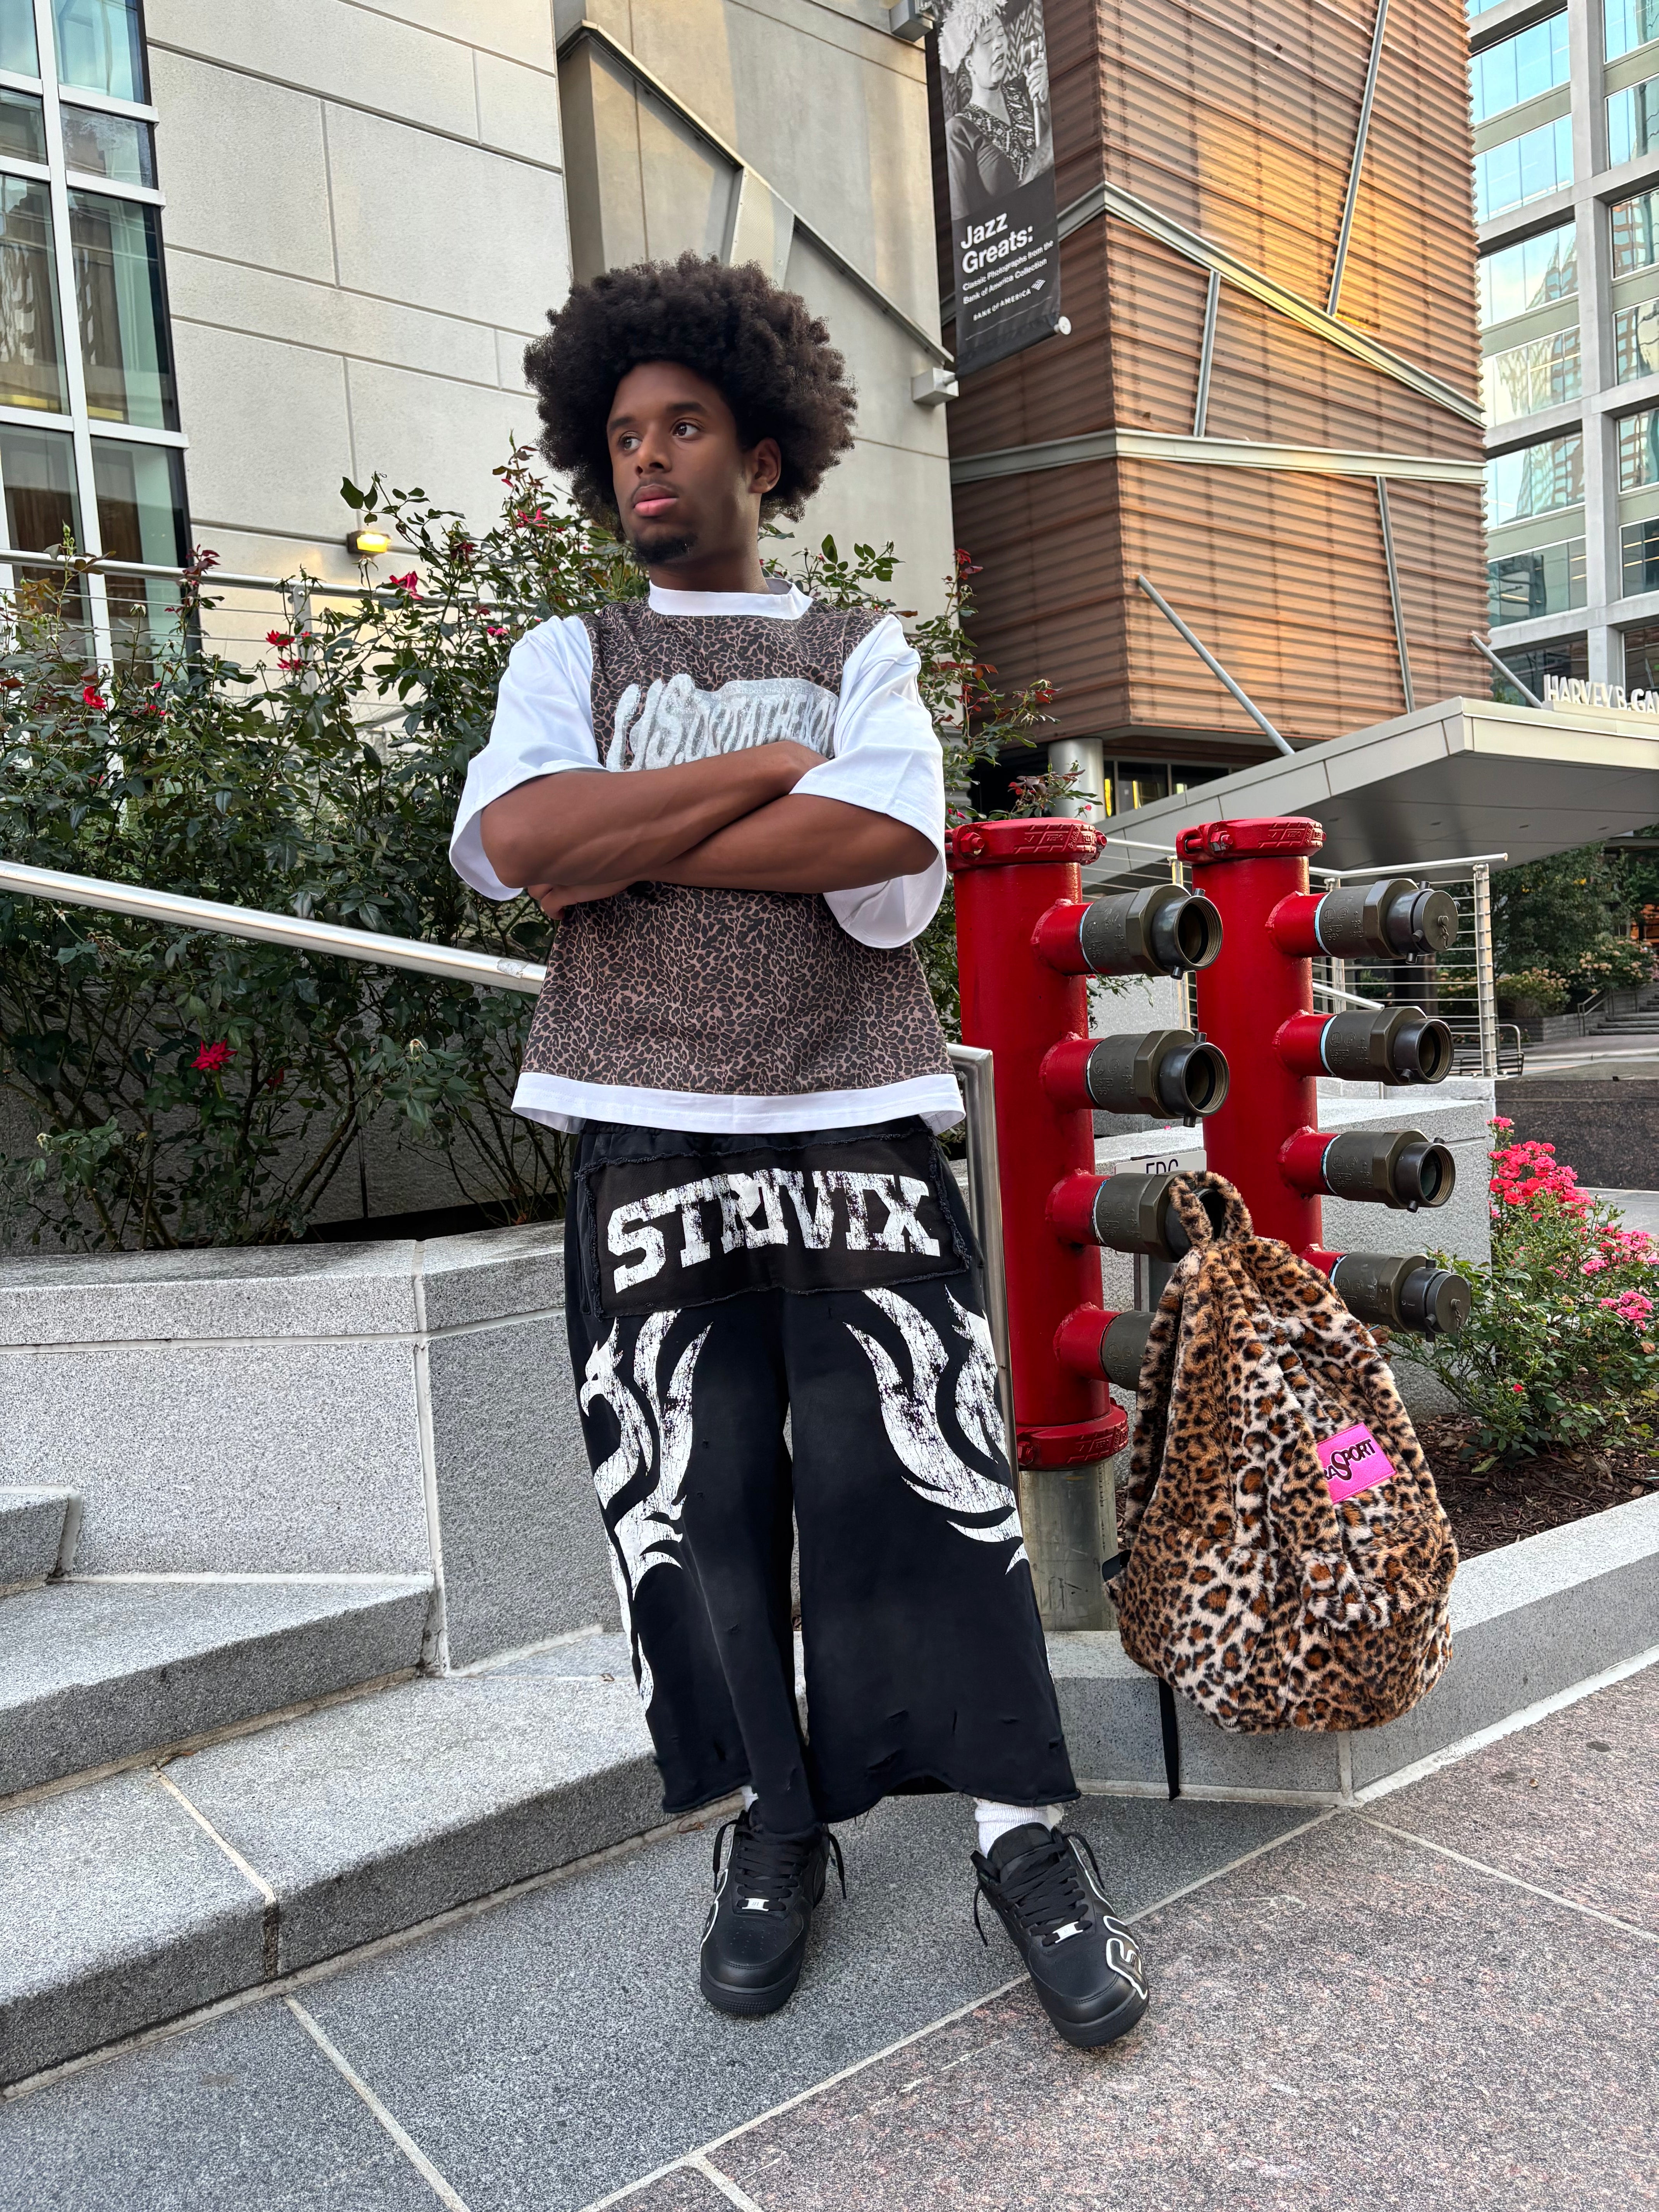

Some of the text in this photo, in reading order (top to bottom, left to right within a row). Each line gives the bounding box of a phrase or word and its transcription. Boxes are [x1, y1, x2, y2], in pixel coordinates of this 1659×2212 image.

[960, 213, 1008, 249] Jazz
[962, 226, 1033, 273] Greats:
[962, 240, 1054, 291] Classic Photographs from the
[963, 259, 1047, 304] Bank of America Collection
[973, 288, 1031, 321] BANK OF AMERICA
[1544, 674, 1613, 708] HARVEY
[1613, 685, 1632, 711] B.
